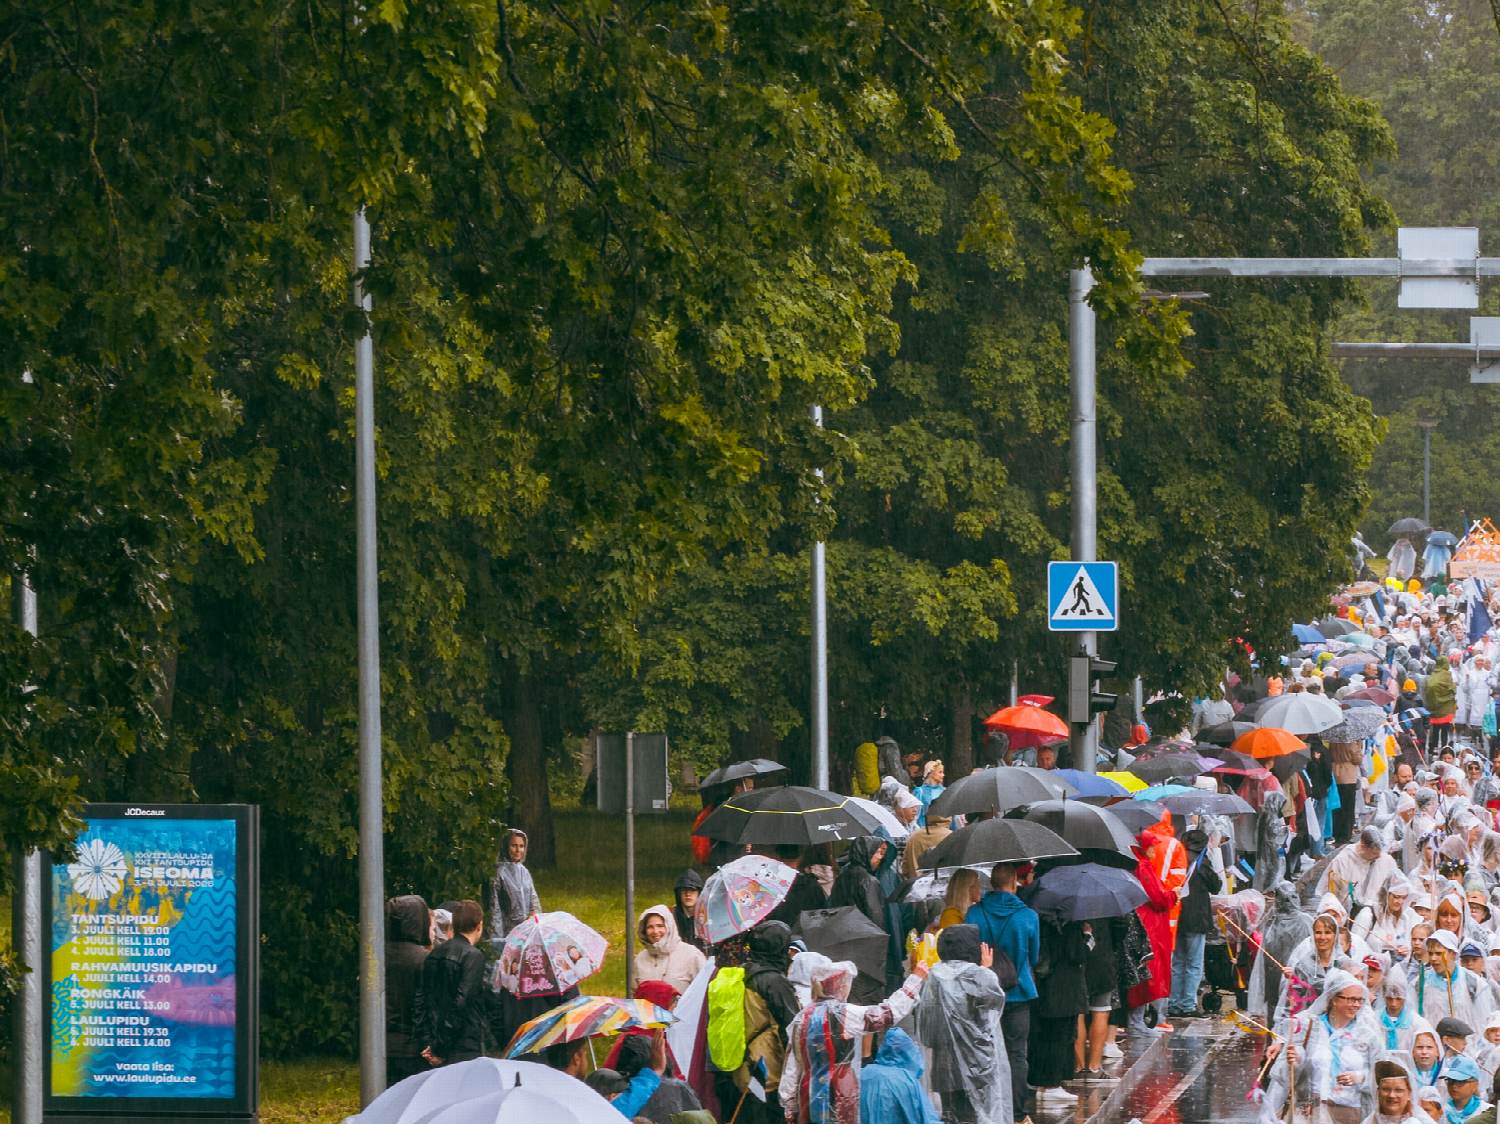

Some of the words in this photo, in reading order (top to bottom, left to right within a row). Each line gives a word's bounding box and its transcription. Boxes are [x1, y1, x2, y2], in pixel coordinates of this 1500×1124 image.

[124, 808, 166, 816] JCDecaux
[134, 867, 214, 880] ISEOMA
[71, 914, 159, 925] TANTSUPIDU
[83, 925, 114, 934] JUULI
[117, 925, 141, 934] KELL
[83, 936, 114, 945] JUULI
[117, 936, 141, 945] KELL
[143, 937, 170, 946] 11.00
[83, 947, 114, 956] JUULI
[117, 947, 141, 956] KELL
[71, 962, 217, 973] RAHVAMUUSIKAPIDU
[83, 973, 114, 982] JUULI
[117, 973, 141, 982] KELL
[70, 987, 146, 999] RONGKÄIK
[83, 1000, 114, 1009] JUULI
[117, 1000, 141, 1009] KELL
[70, 1015, 150, 1026] LAULUPIDU
[83, 1027, 114, 1036] JUULI
[117, 1027, 141, 1036] KELL
[83, 1038, 114, 1047] JUULI
[117, 1038, 141, 1047] KELL
[116, 1063, 150, 1071] vaata
[152, 1061, 175, 1072] lisa:
[93, 1072, 197, 1085] www.laulupidu.ee
